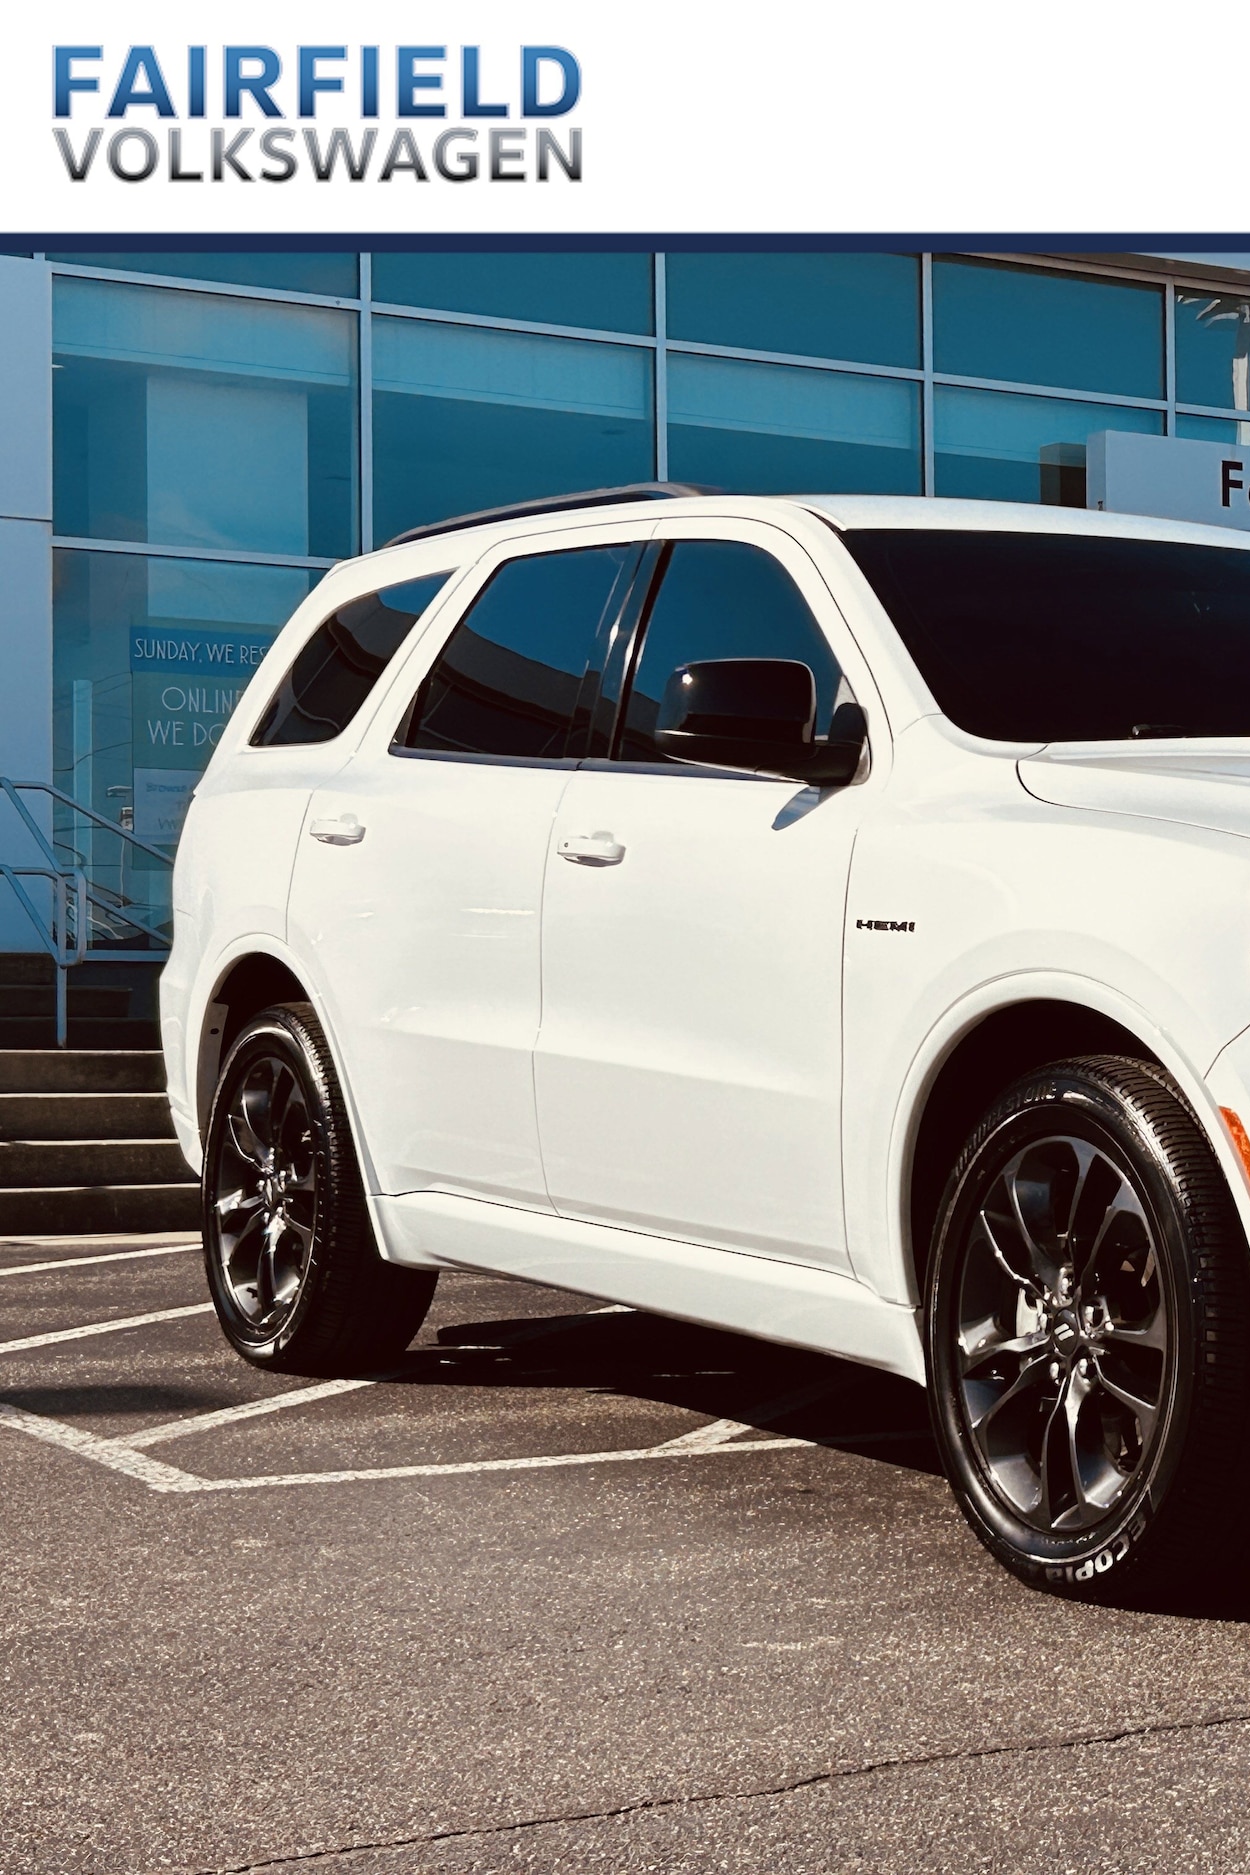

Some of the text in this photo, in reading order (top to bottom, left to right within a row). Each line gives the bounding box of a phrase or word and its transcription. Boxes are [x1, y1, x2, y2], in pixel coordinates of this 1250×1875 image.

[206, 643, 235, 664] WE
[147, 720, 184, 746] WE
[856, 919, 916, 933] HEMI
